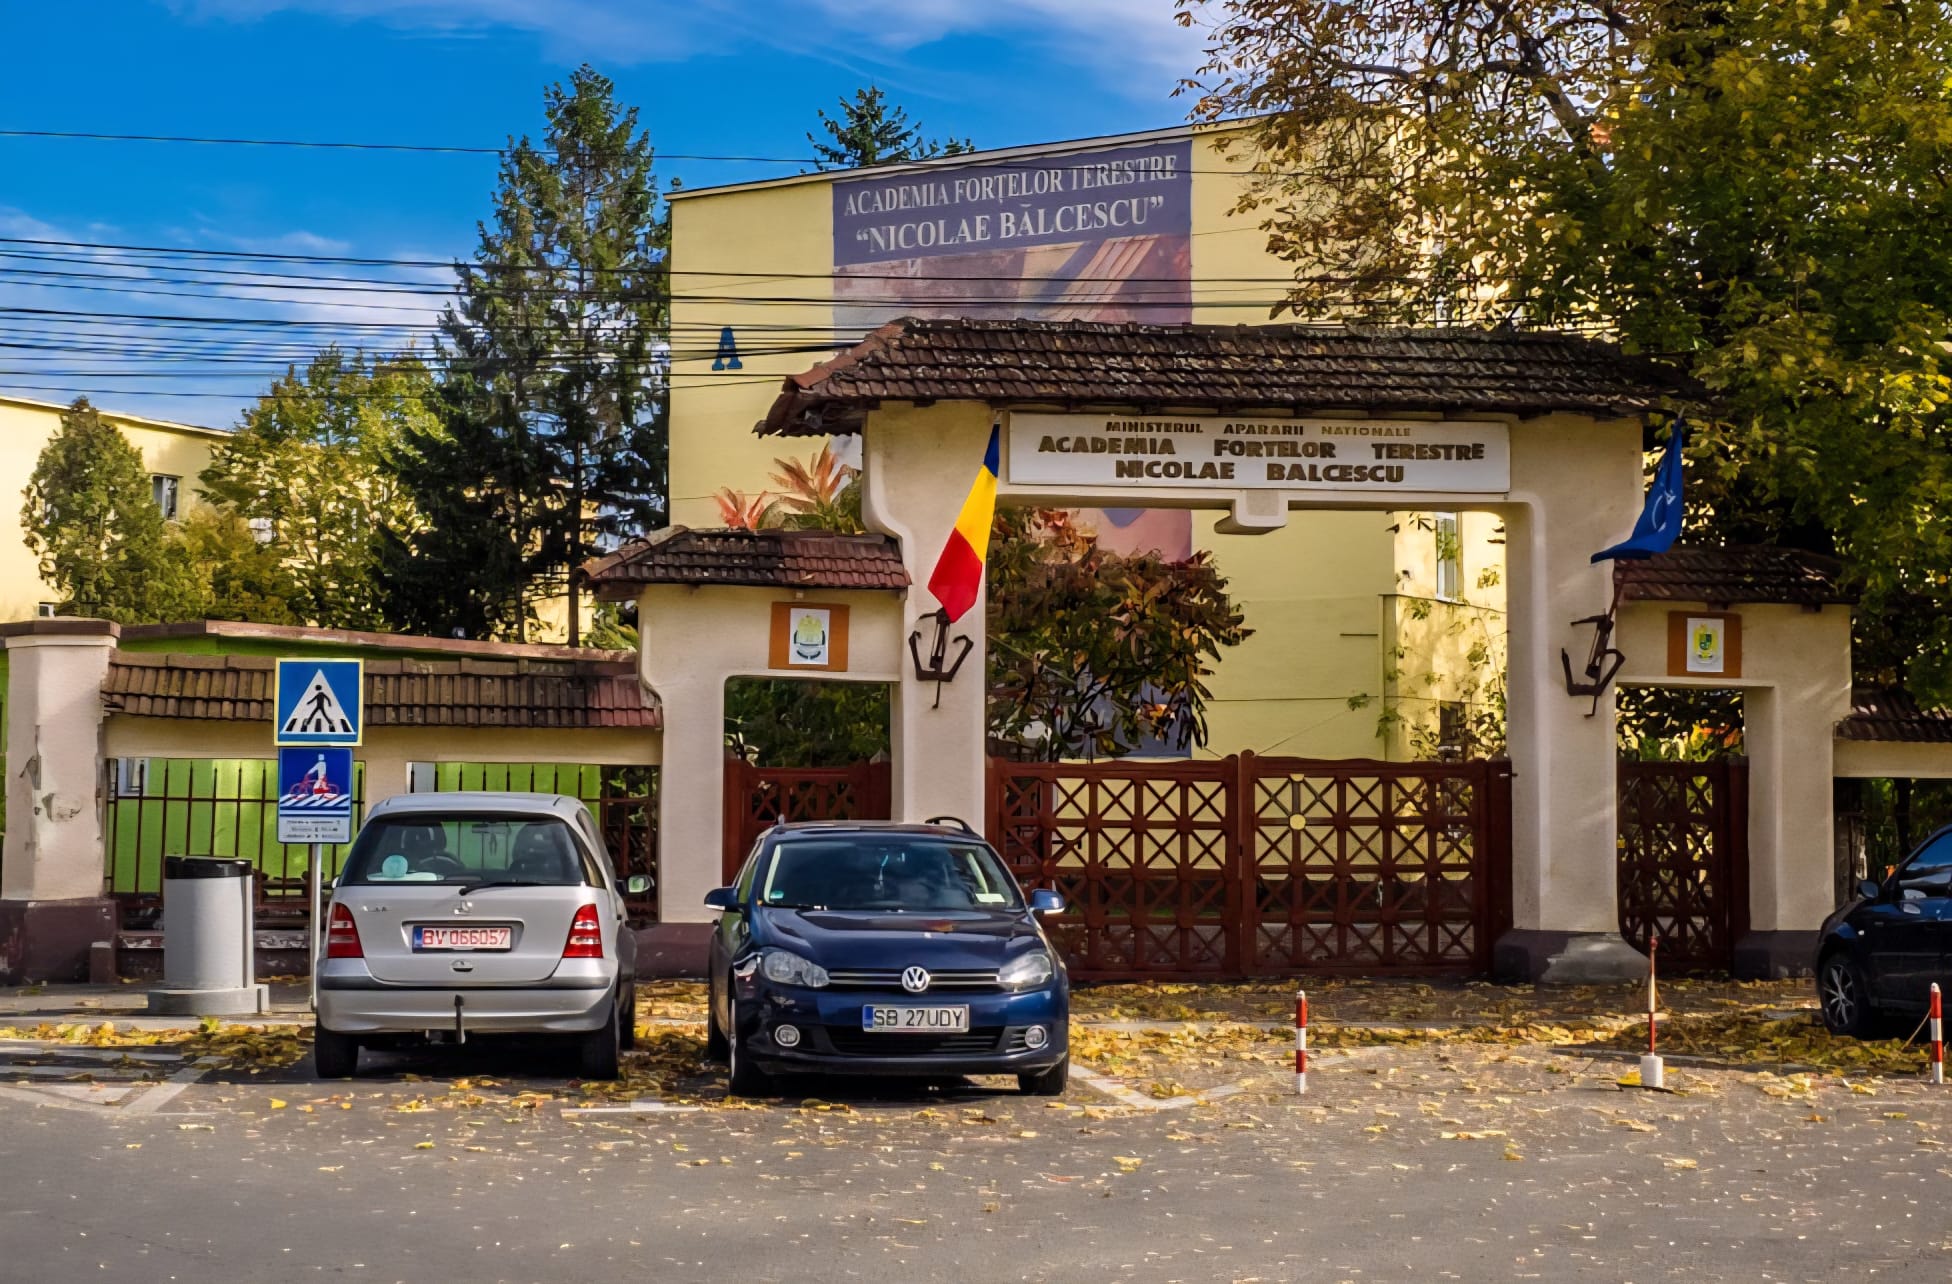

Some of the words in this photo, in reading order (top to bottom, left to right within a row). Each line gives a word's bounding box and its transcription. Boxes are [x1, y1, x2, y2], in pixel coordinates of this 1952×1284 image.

[844, 182, 949, 216] ACADEMIA
[1071, 155, 1177, 191] TERESTRE
[711, 326, 743, 371] A
[1105, 421, 1204, 433] MINISTERUL
[1223, 423, 1304, 435] APARARII
[1321, 426, 1411, 437] NATIONALE
[1038, 435, 1176, 455] ACADEMIA
[1213, 439, 1337, 458] FORTELOR
[1371, 443, 1485, 460] TERESTRE
[1115, 459, 1235, 480] NICOLAE
[1266, 463, 1404, 482] BALCESCU
[423, 929, 447, 945] BV
[449, 929, 509, 945] 066057
[874, 1009, 898, 1027] SB
